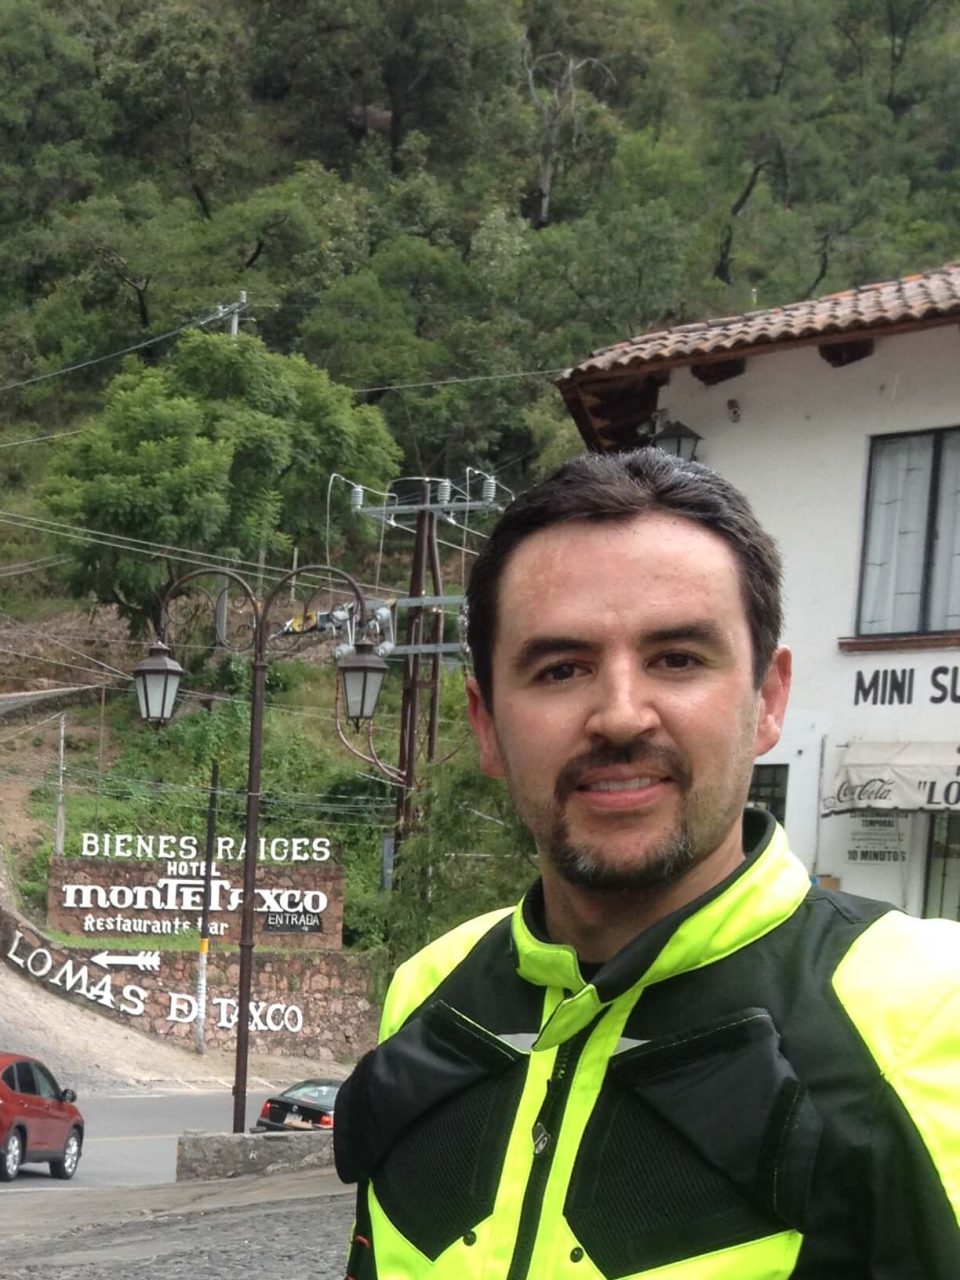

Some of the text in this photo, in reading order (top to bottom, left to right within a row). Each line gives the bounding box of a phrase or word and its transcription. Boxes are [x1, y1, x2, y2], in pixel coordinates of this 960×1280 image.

[853, 668, 915, 706] MINI
[81, 832, 198, 859] BIENES
[860, 850, 906, 862] MINUTOS
[7, 930, 147, 1016] LOMAS
